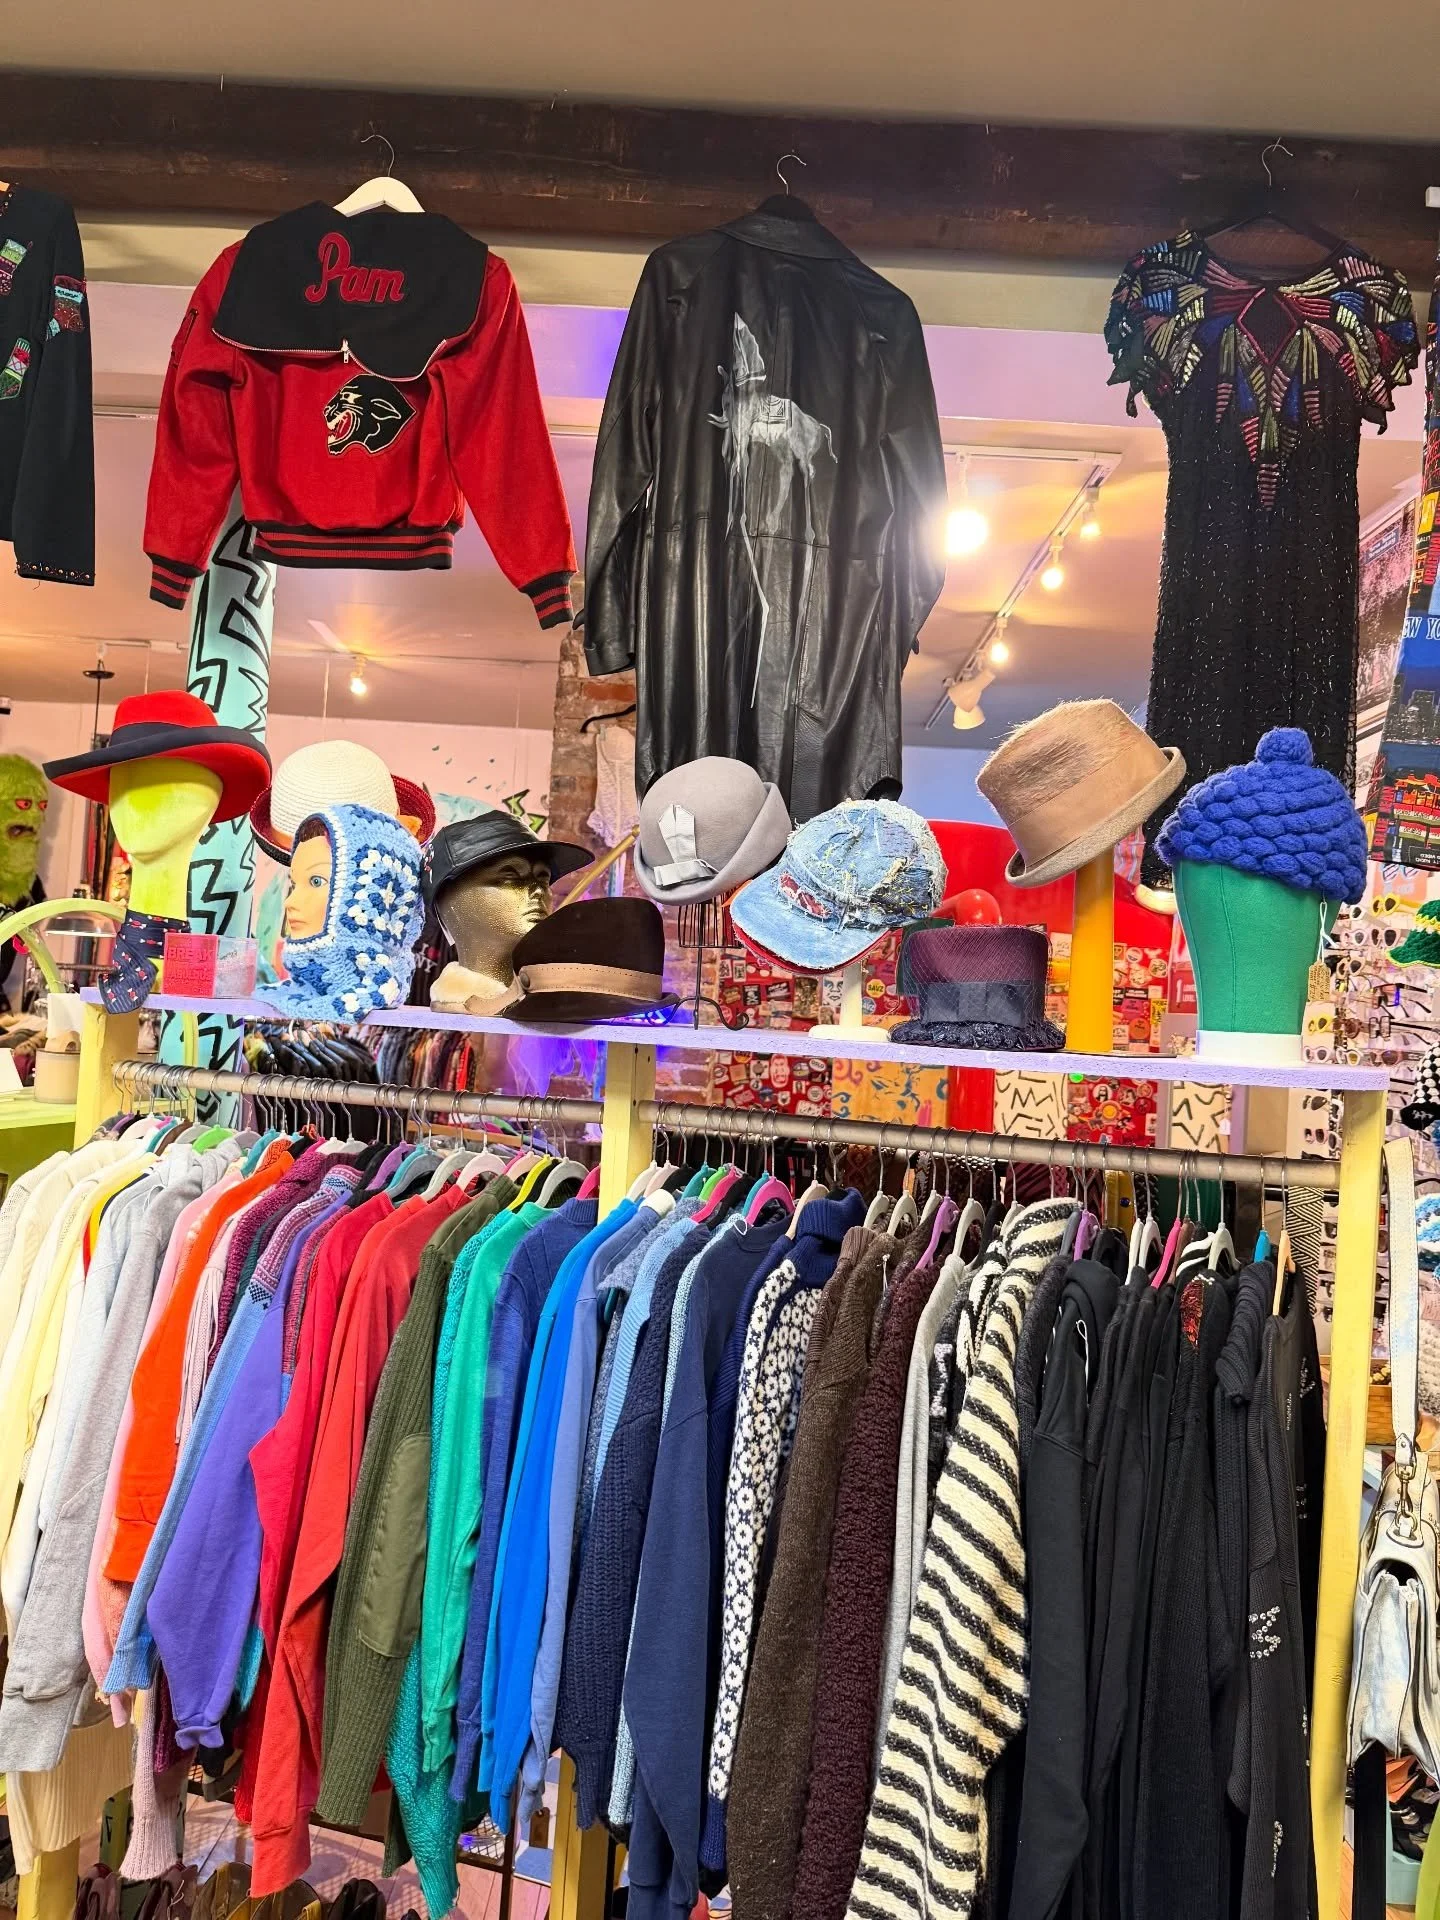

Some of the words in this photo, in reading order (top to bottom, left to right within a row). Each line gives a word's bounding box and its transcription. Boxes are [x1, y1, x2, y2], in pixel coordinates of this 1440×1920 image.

[305, 232, 405, 302] Pam
[1402, 617, 1423, 638] EW
[1426, 618, 1440, 640] YO
[167, 947, 215, 961] BREAK
[419, 942, 430, 956] I
[414, 952, 438, 974] NY
